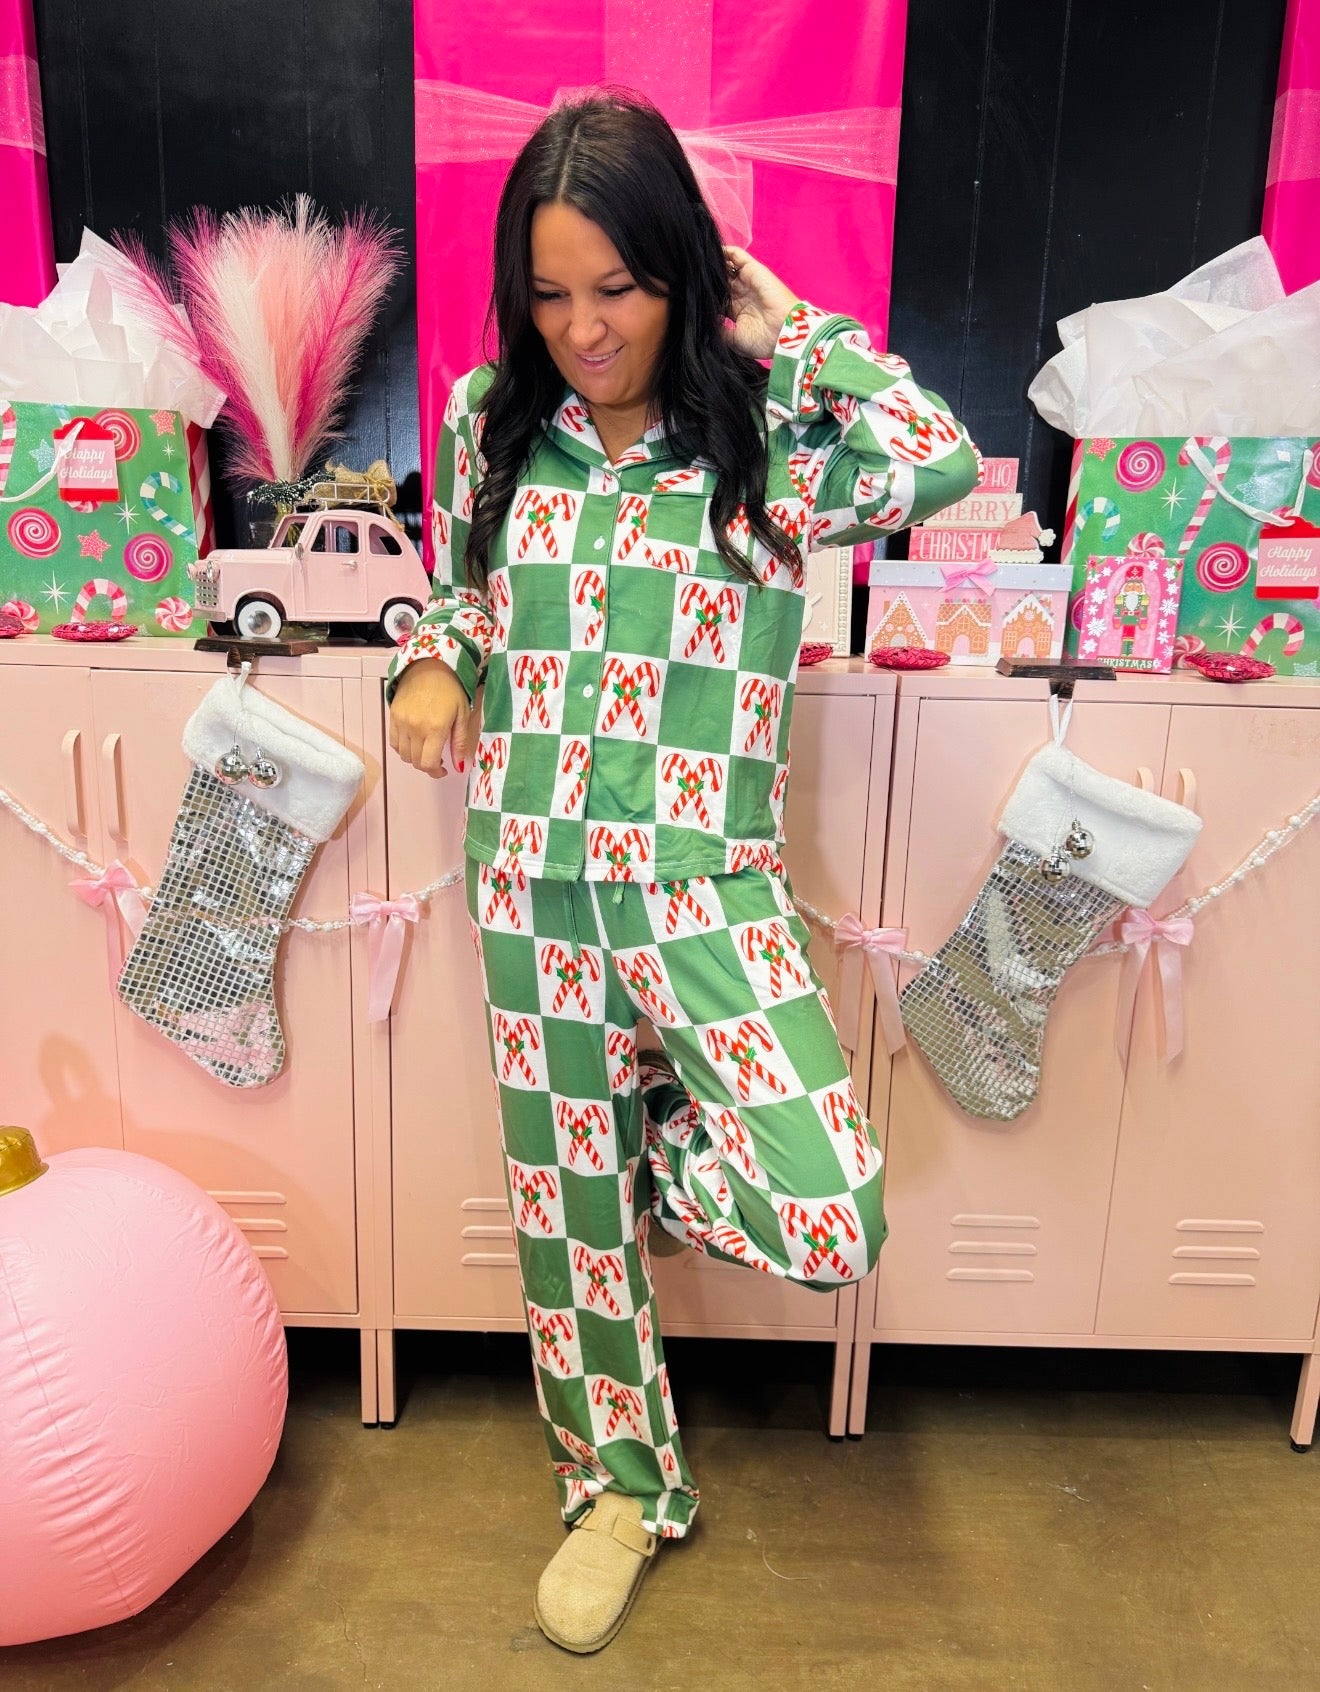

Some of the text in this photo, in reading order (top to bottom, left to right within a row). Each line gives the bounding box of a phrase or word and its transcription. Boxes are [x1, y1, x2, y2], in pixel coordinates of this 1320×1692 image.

[60, 466, 113, 484] Holidays
[991, 464, 1012, 487] HO
[934, 501, 1016, 521] MERRY
[1267, 545, 1312, 562] Happy
[1260, 564, 1317, 581] Holidays
